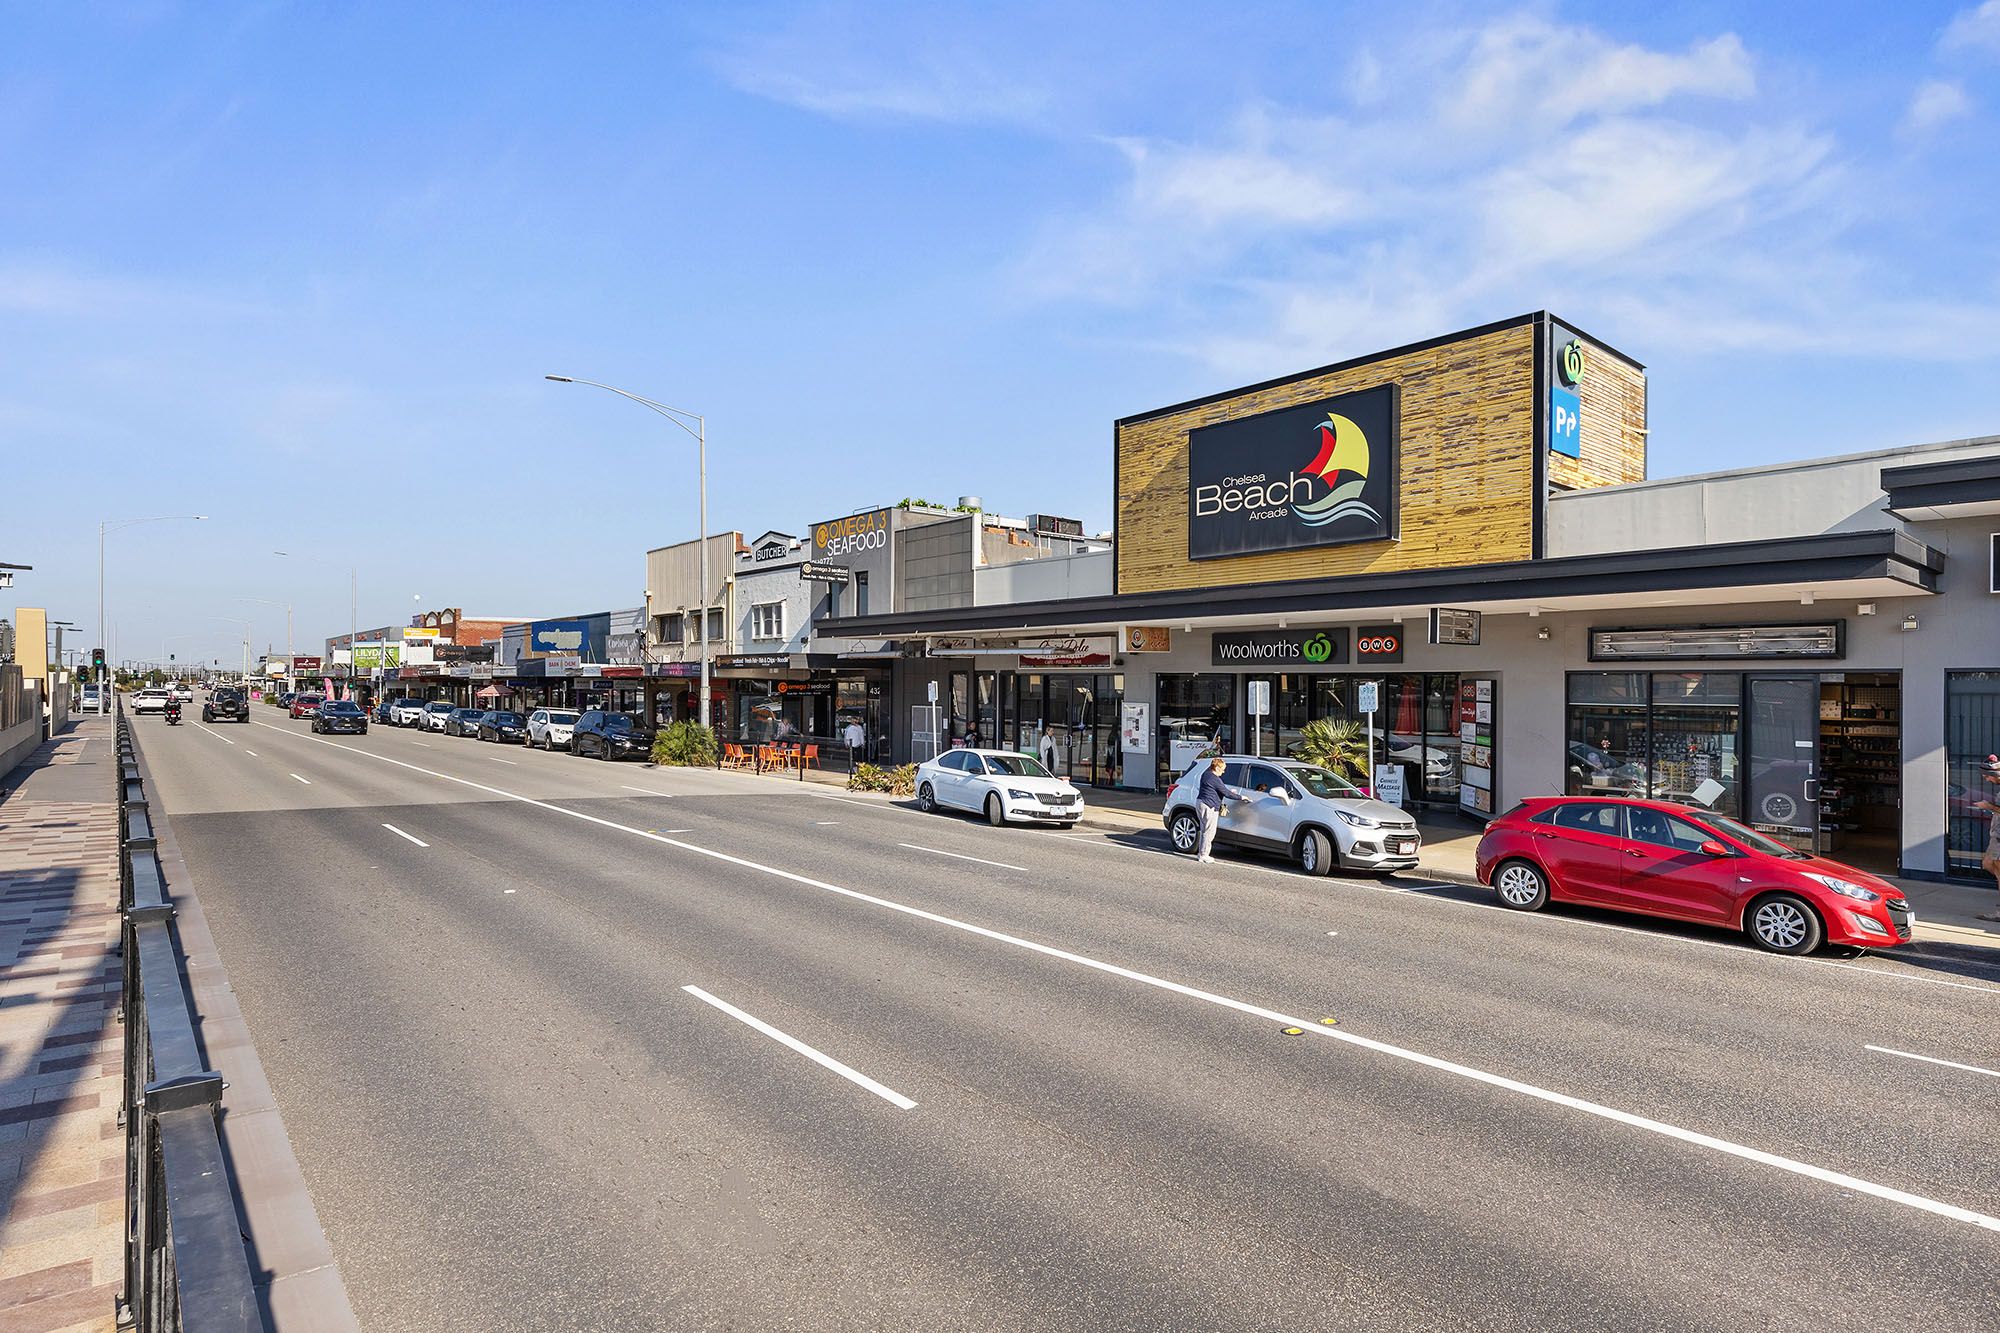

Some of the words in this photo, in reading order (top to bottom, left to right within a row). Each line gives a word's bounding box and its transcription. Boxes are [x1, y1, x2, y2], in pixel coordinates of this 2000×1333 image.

[1222, 473, 1266, 488] Chelsea
[1196, 471, 1313, 517] Beach
[1248, 507, 1288, 521] Arcade
[829, 514, 875, 539] OMEGA
[879, 511, 887, 529] 3
[827, 529, 887, 557] SEAFOOD
[756, 545, 787, 560] BUTCHER
[355, 648, 394, 657] LILYDE
